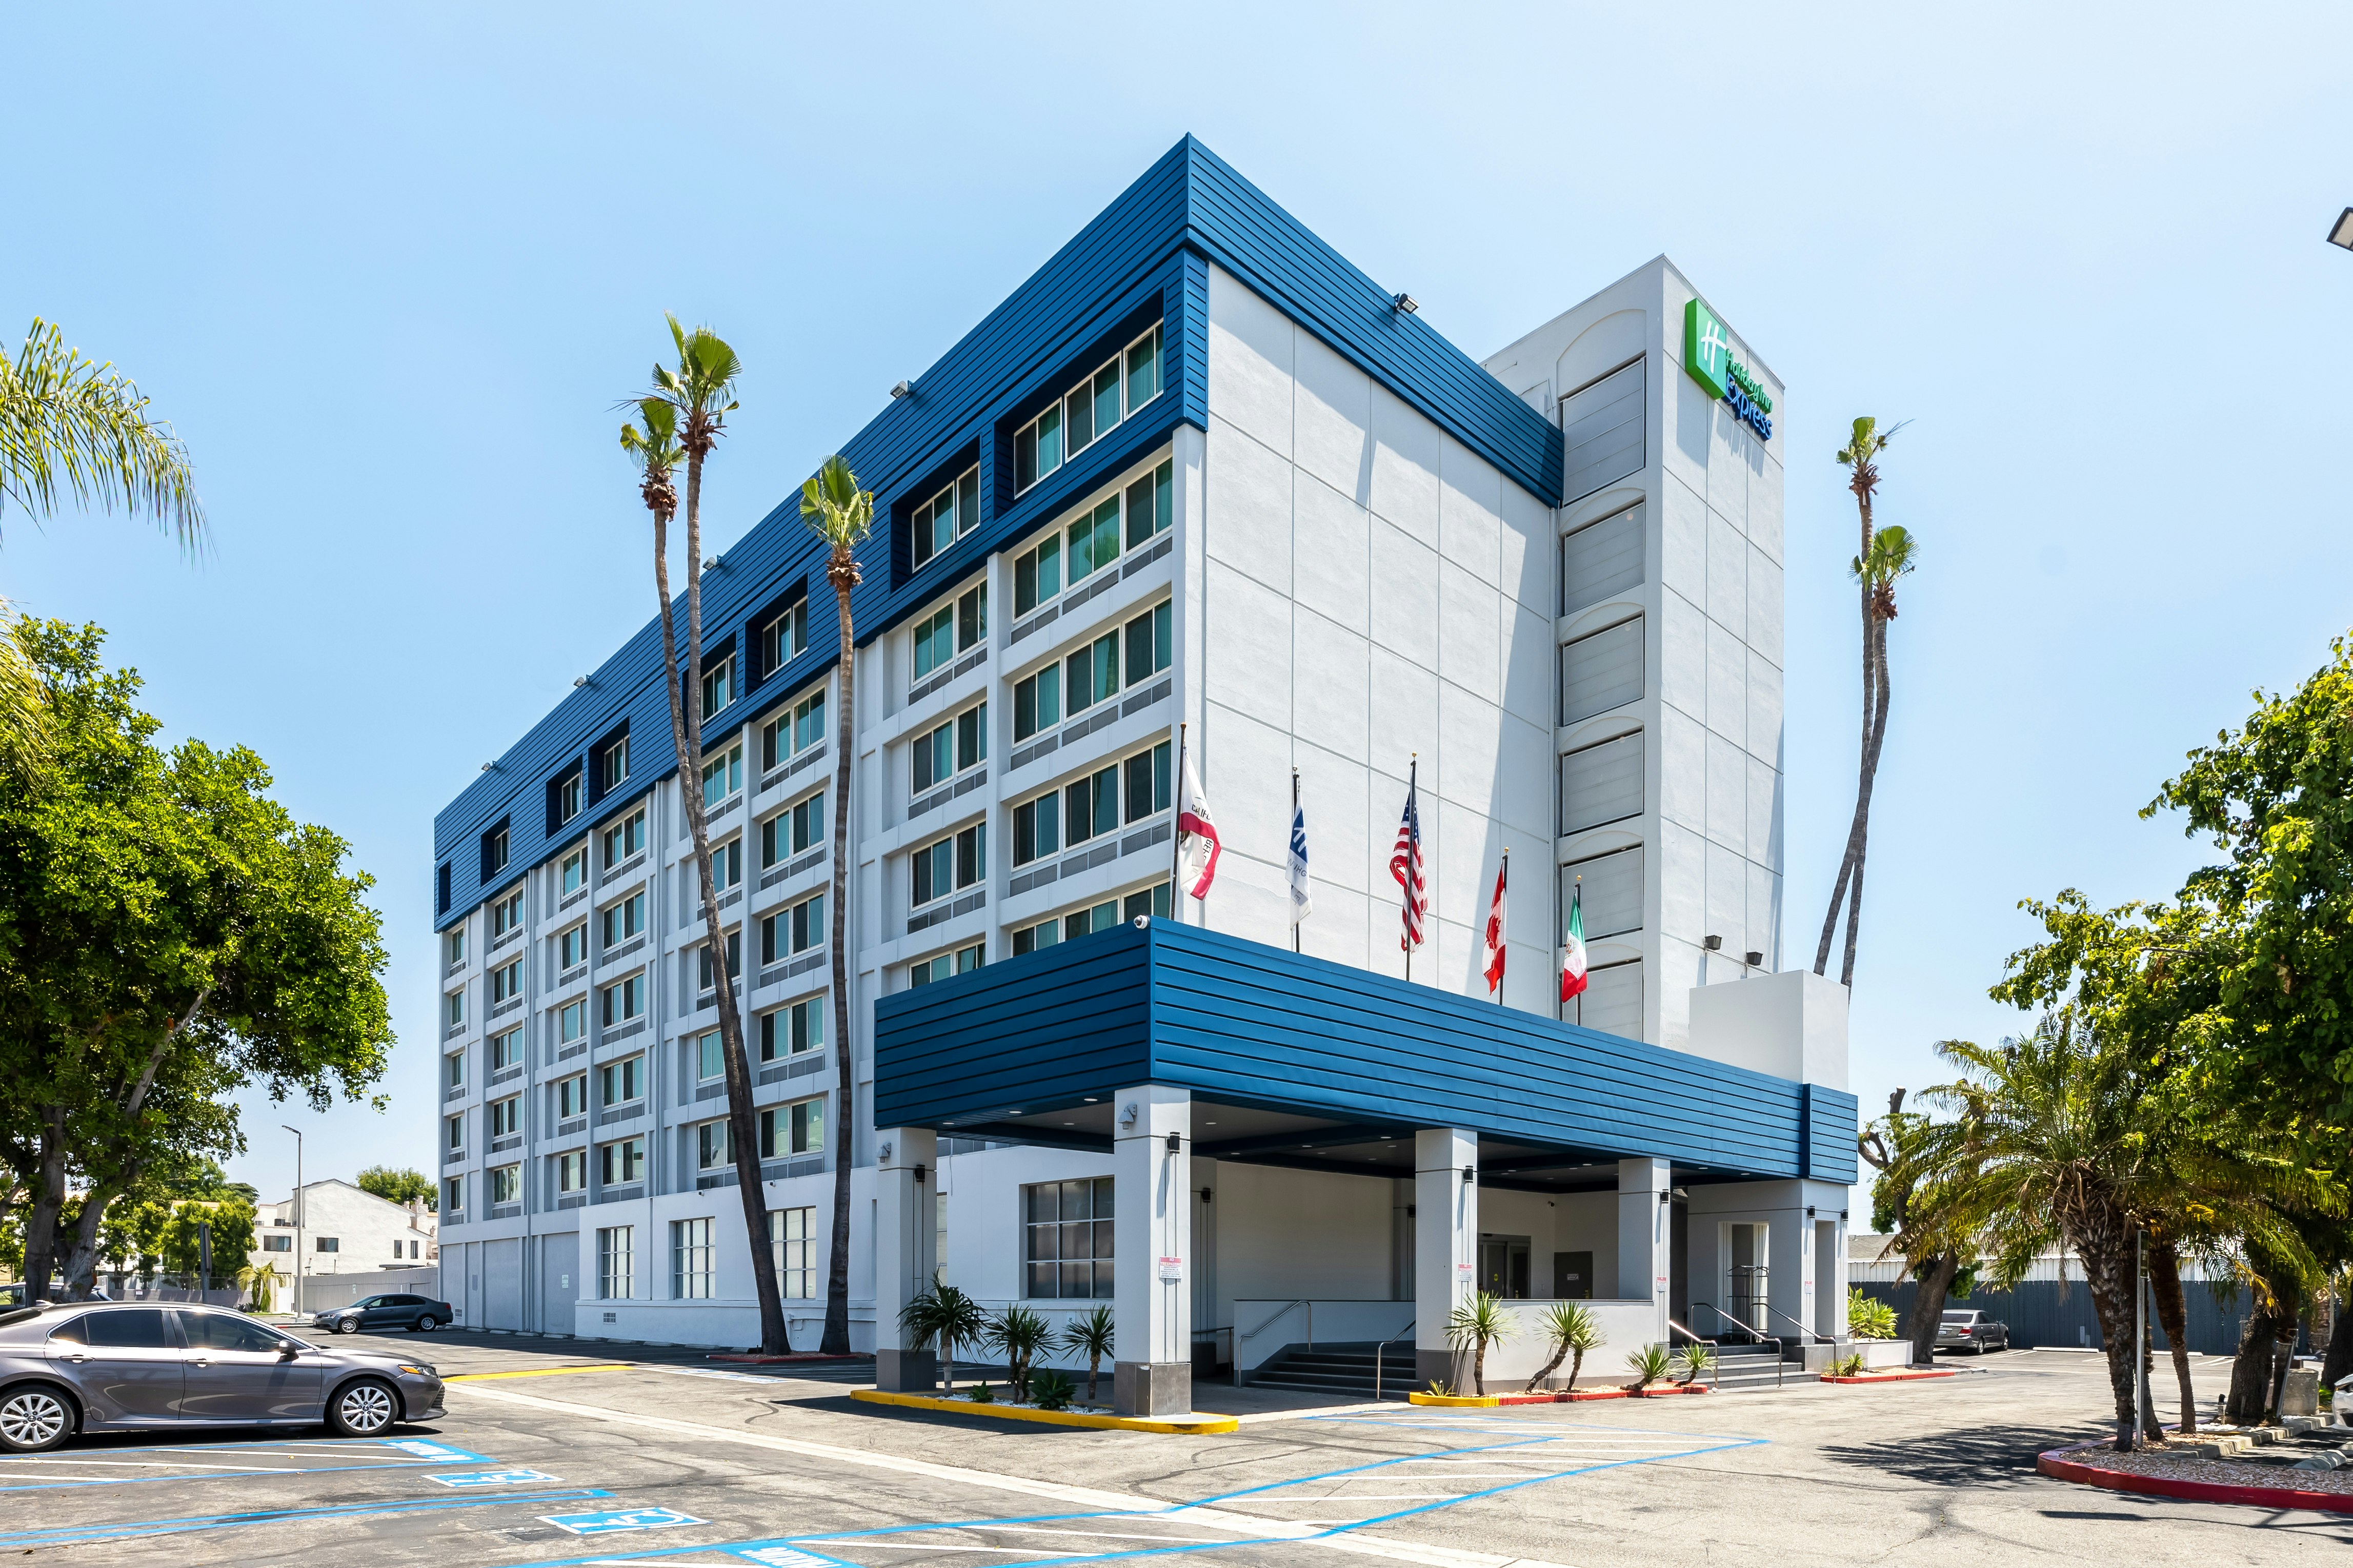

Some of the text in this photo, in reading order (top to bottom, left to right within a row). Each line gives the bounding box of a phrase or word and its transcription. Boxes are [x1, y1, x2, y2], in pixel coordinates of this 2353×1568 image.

[1726, 348, 1773, 413] Holiday Inn
[1725, 372, 1773, 440] Express
[1294, 864, 1307, 877] IHG
[739, 1547, 842, 1568] ARKING
